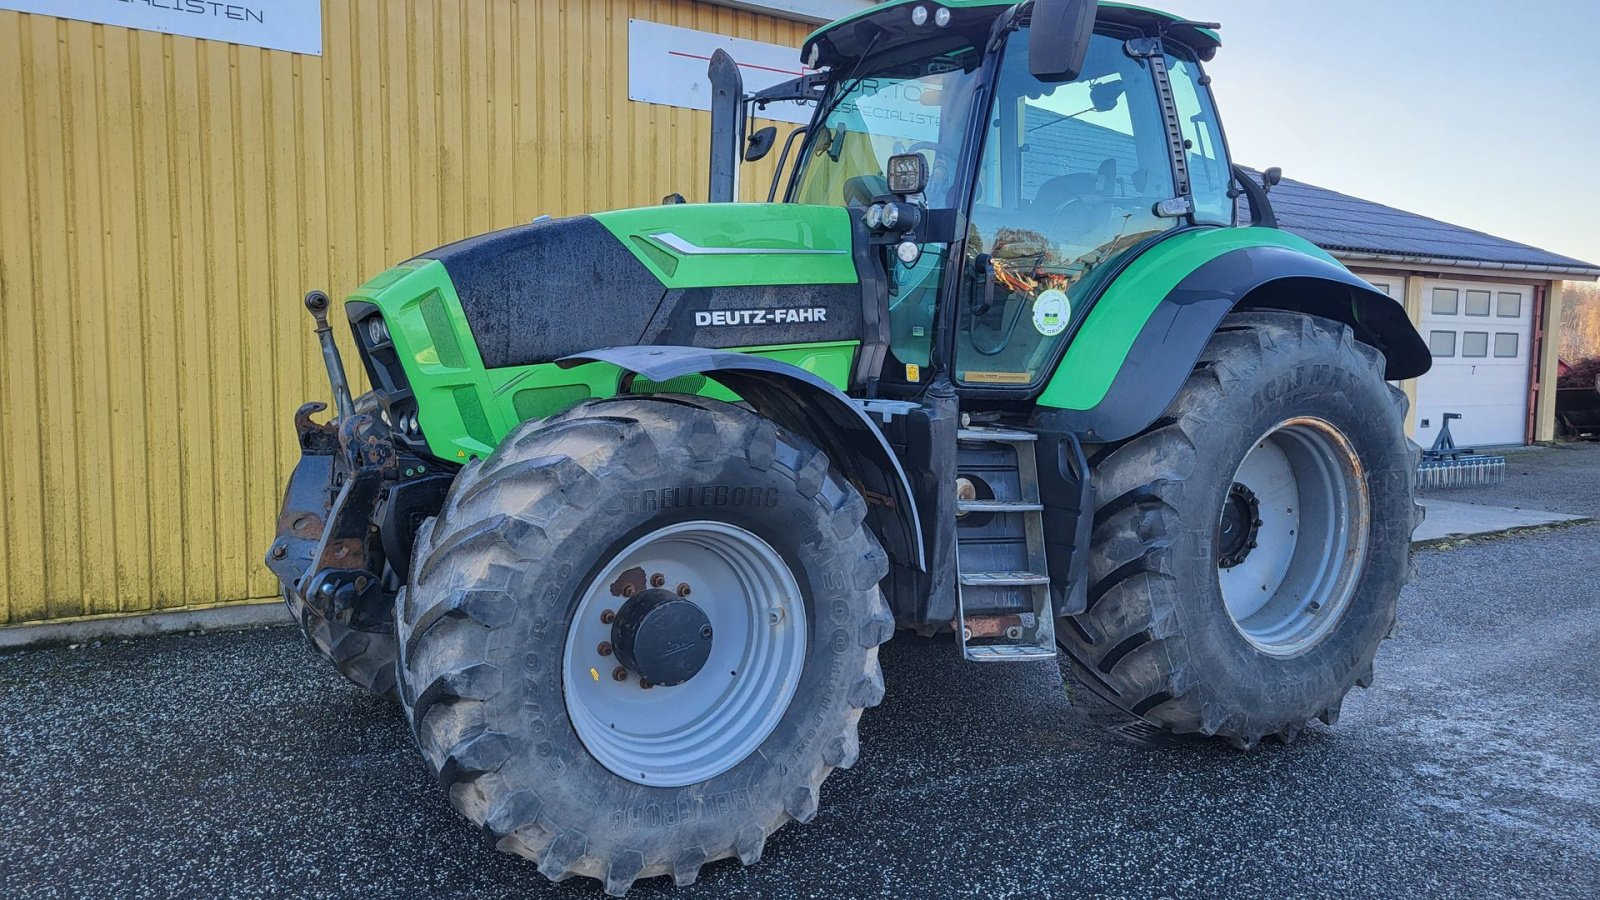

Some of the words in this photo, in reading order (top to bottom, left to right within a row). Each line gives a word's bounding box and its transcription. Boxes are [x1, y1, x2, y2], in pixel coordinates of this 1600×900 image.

[695, 308, 827, 326] DEUTZ-FAHR
[1471, 365, 1476, 375] 7
[620, 485, 780, 514] TRELLEBORG
